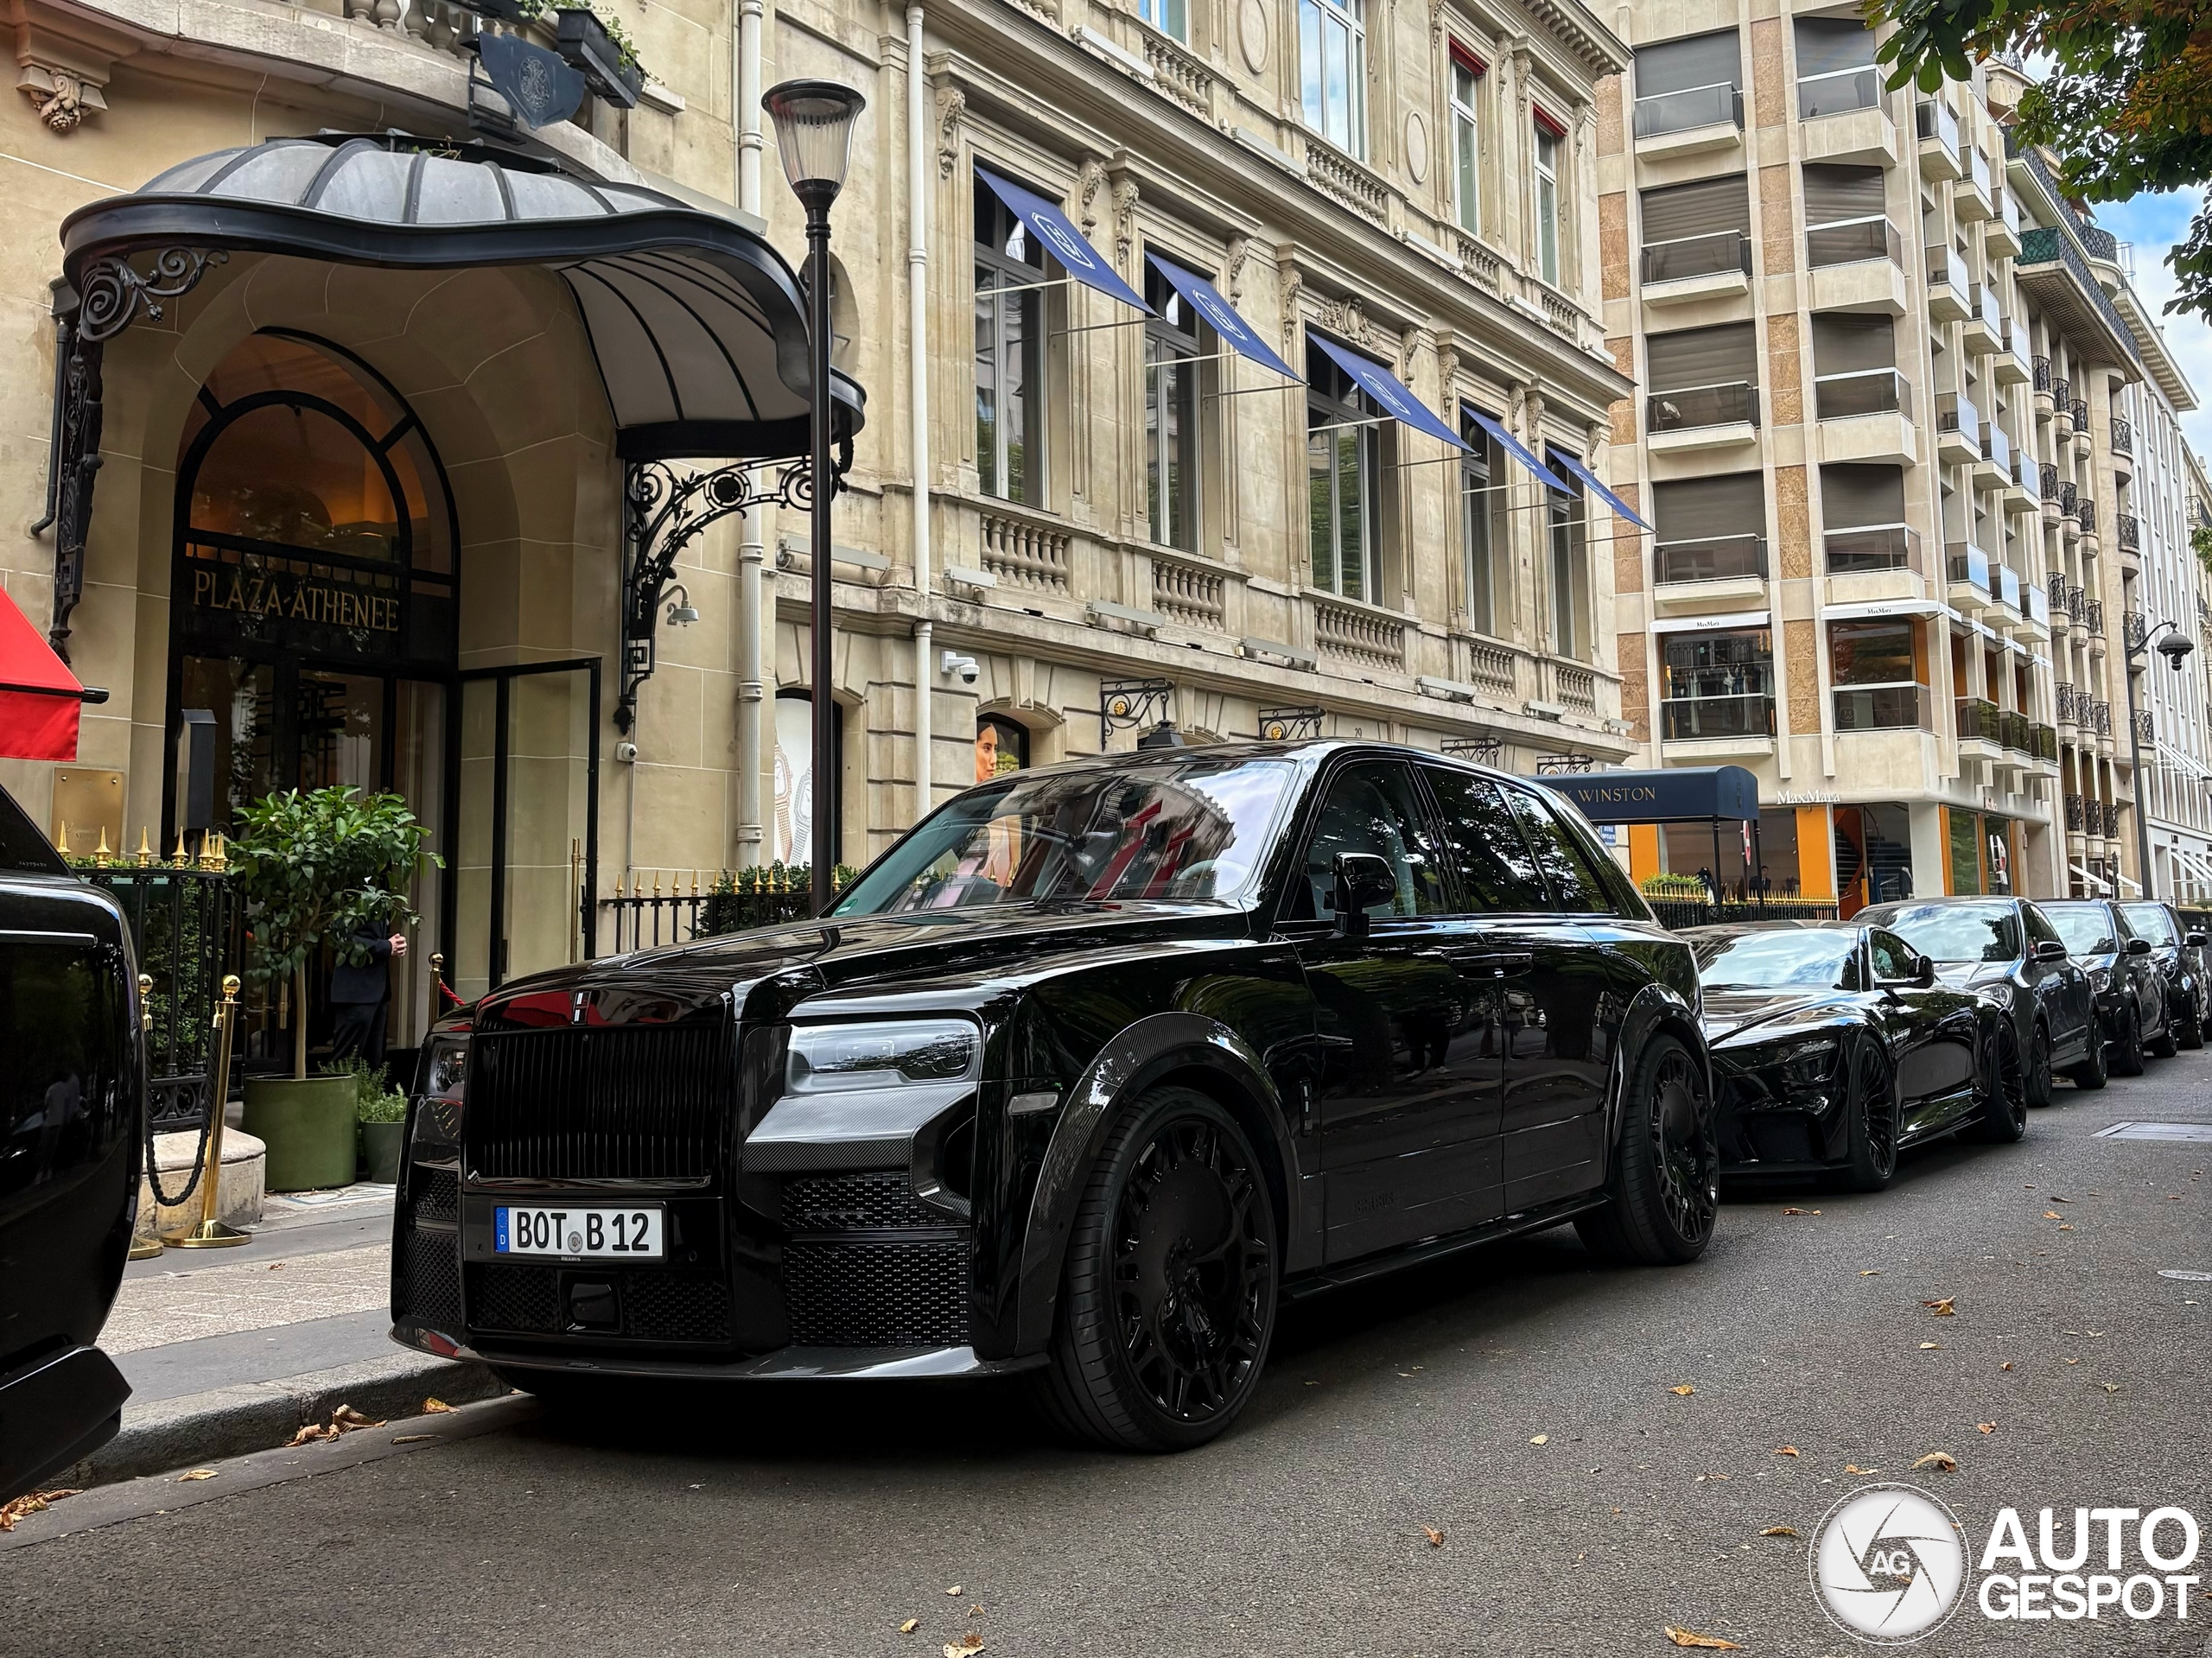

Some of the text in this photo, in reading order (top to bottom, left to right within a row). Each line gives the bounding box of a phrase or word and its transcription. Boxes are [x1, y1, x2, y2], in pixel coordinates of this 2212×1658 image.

[1578, 786, 1656, 803] WINSTON
[1777, 789, 1840, 805] MaxMara
[517, 1211, 567, 1250] BOT
[499, 1234, 506, 1245] D
